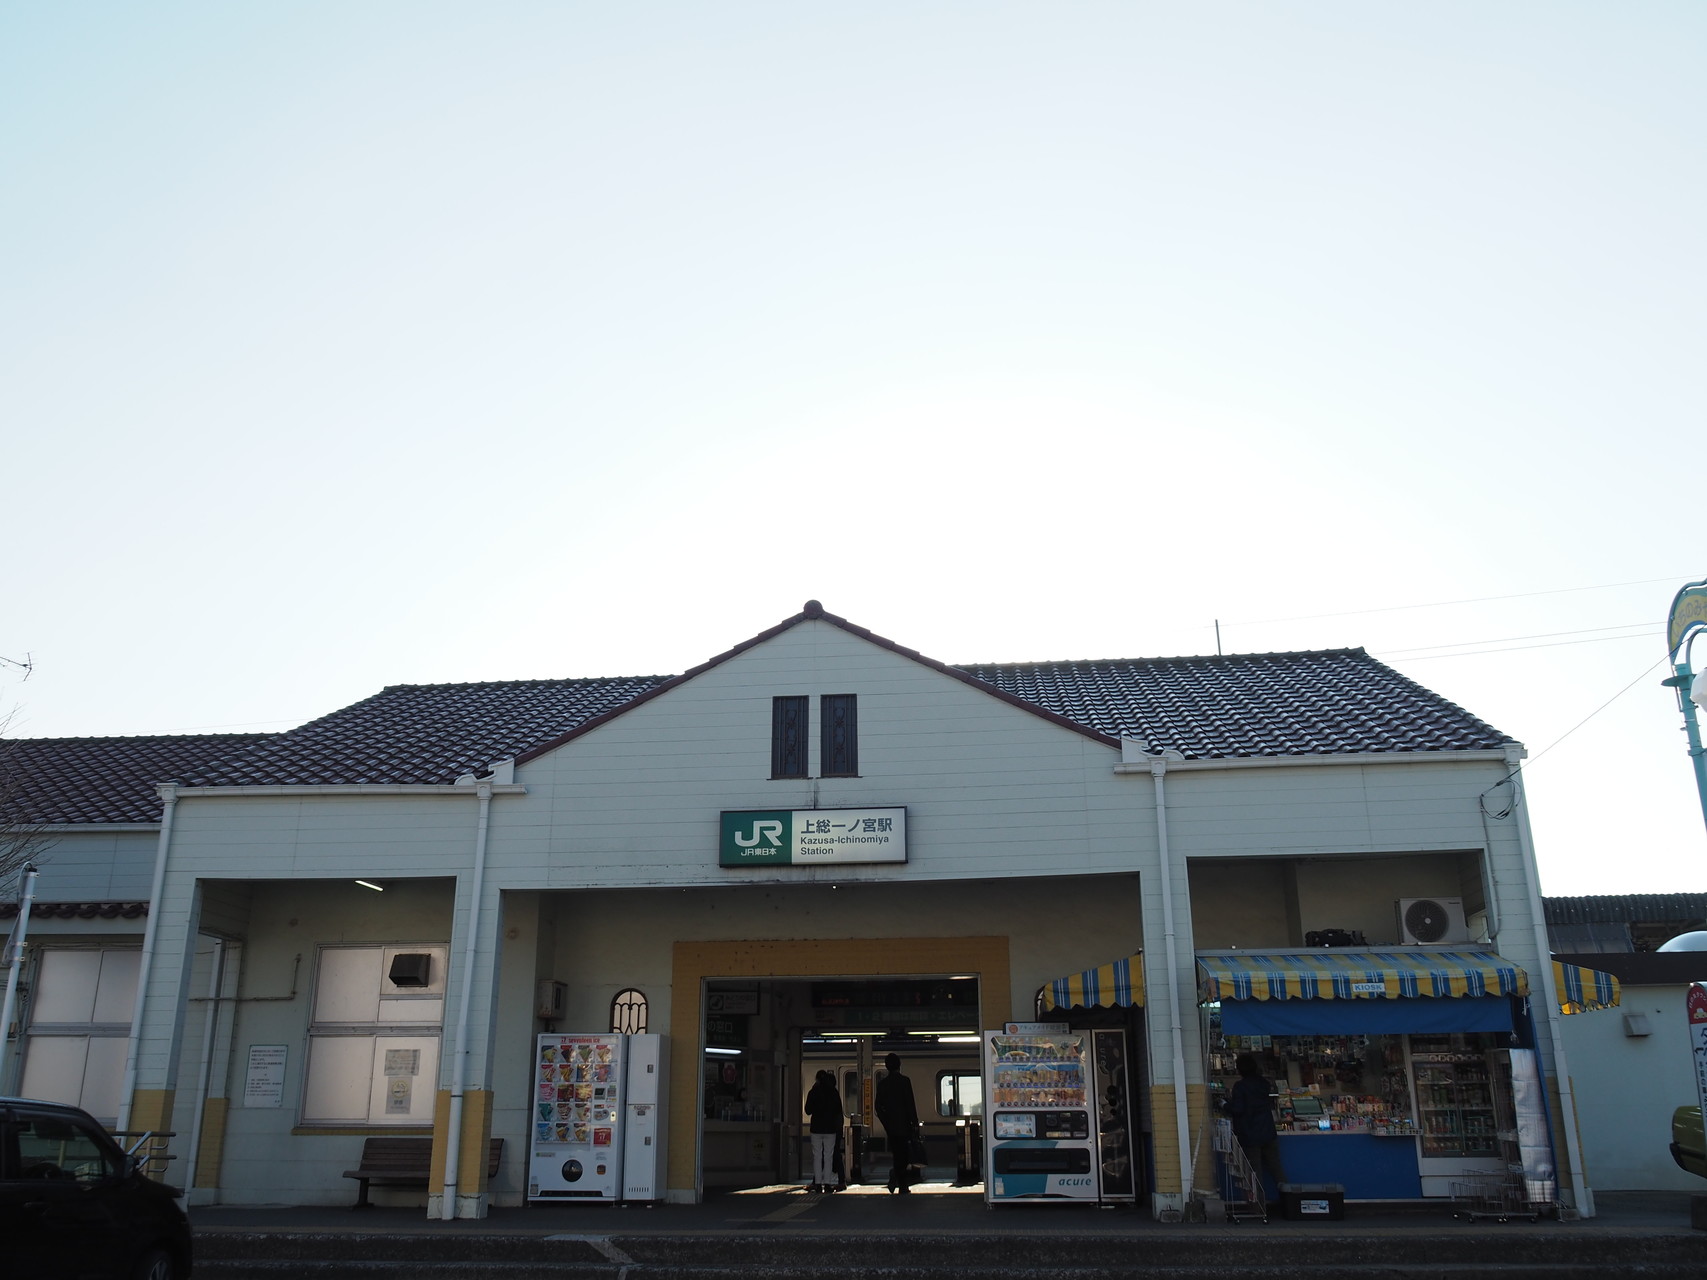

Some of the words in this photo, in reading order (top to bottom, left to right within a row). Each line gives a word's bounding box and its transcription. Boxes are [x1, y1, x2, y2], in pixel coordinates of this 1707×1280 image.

[800, 817, 893, 834] 上総一ノ宮駅
[735, 819, 783, 847] JR
[800, 834, 889, 846] Kazusa-Ichinomiya
[741, 847, 777, 856] JR東日本
[800, 846, 834, 856] Station
[1353, 983, 1383, 992] KIOSK
[1058, 1175, 1092, 1187] acure
